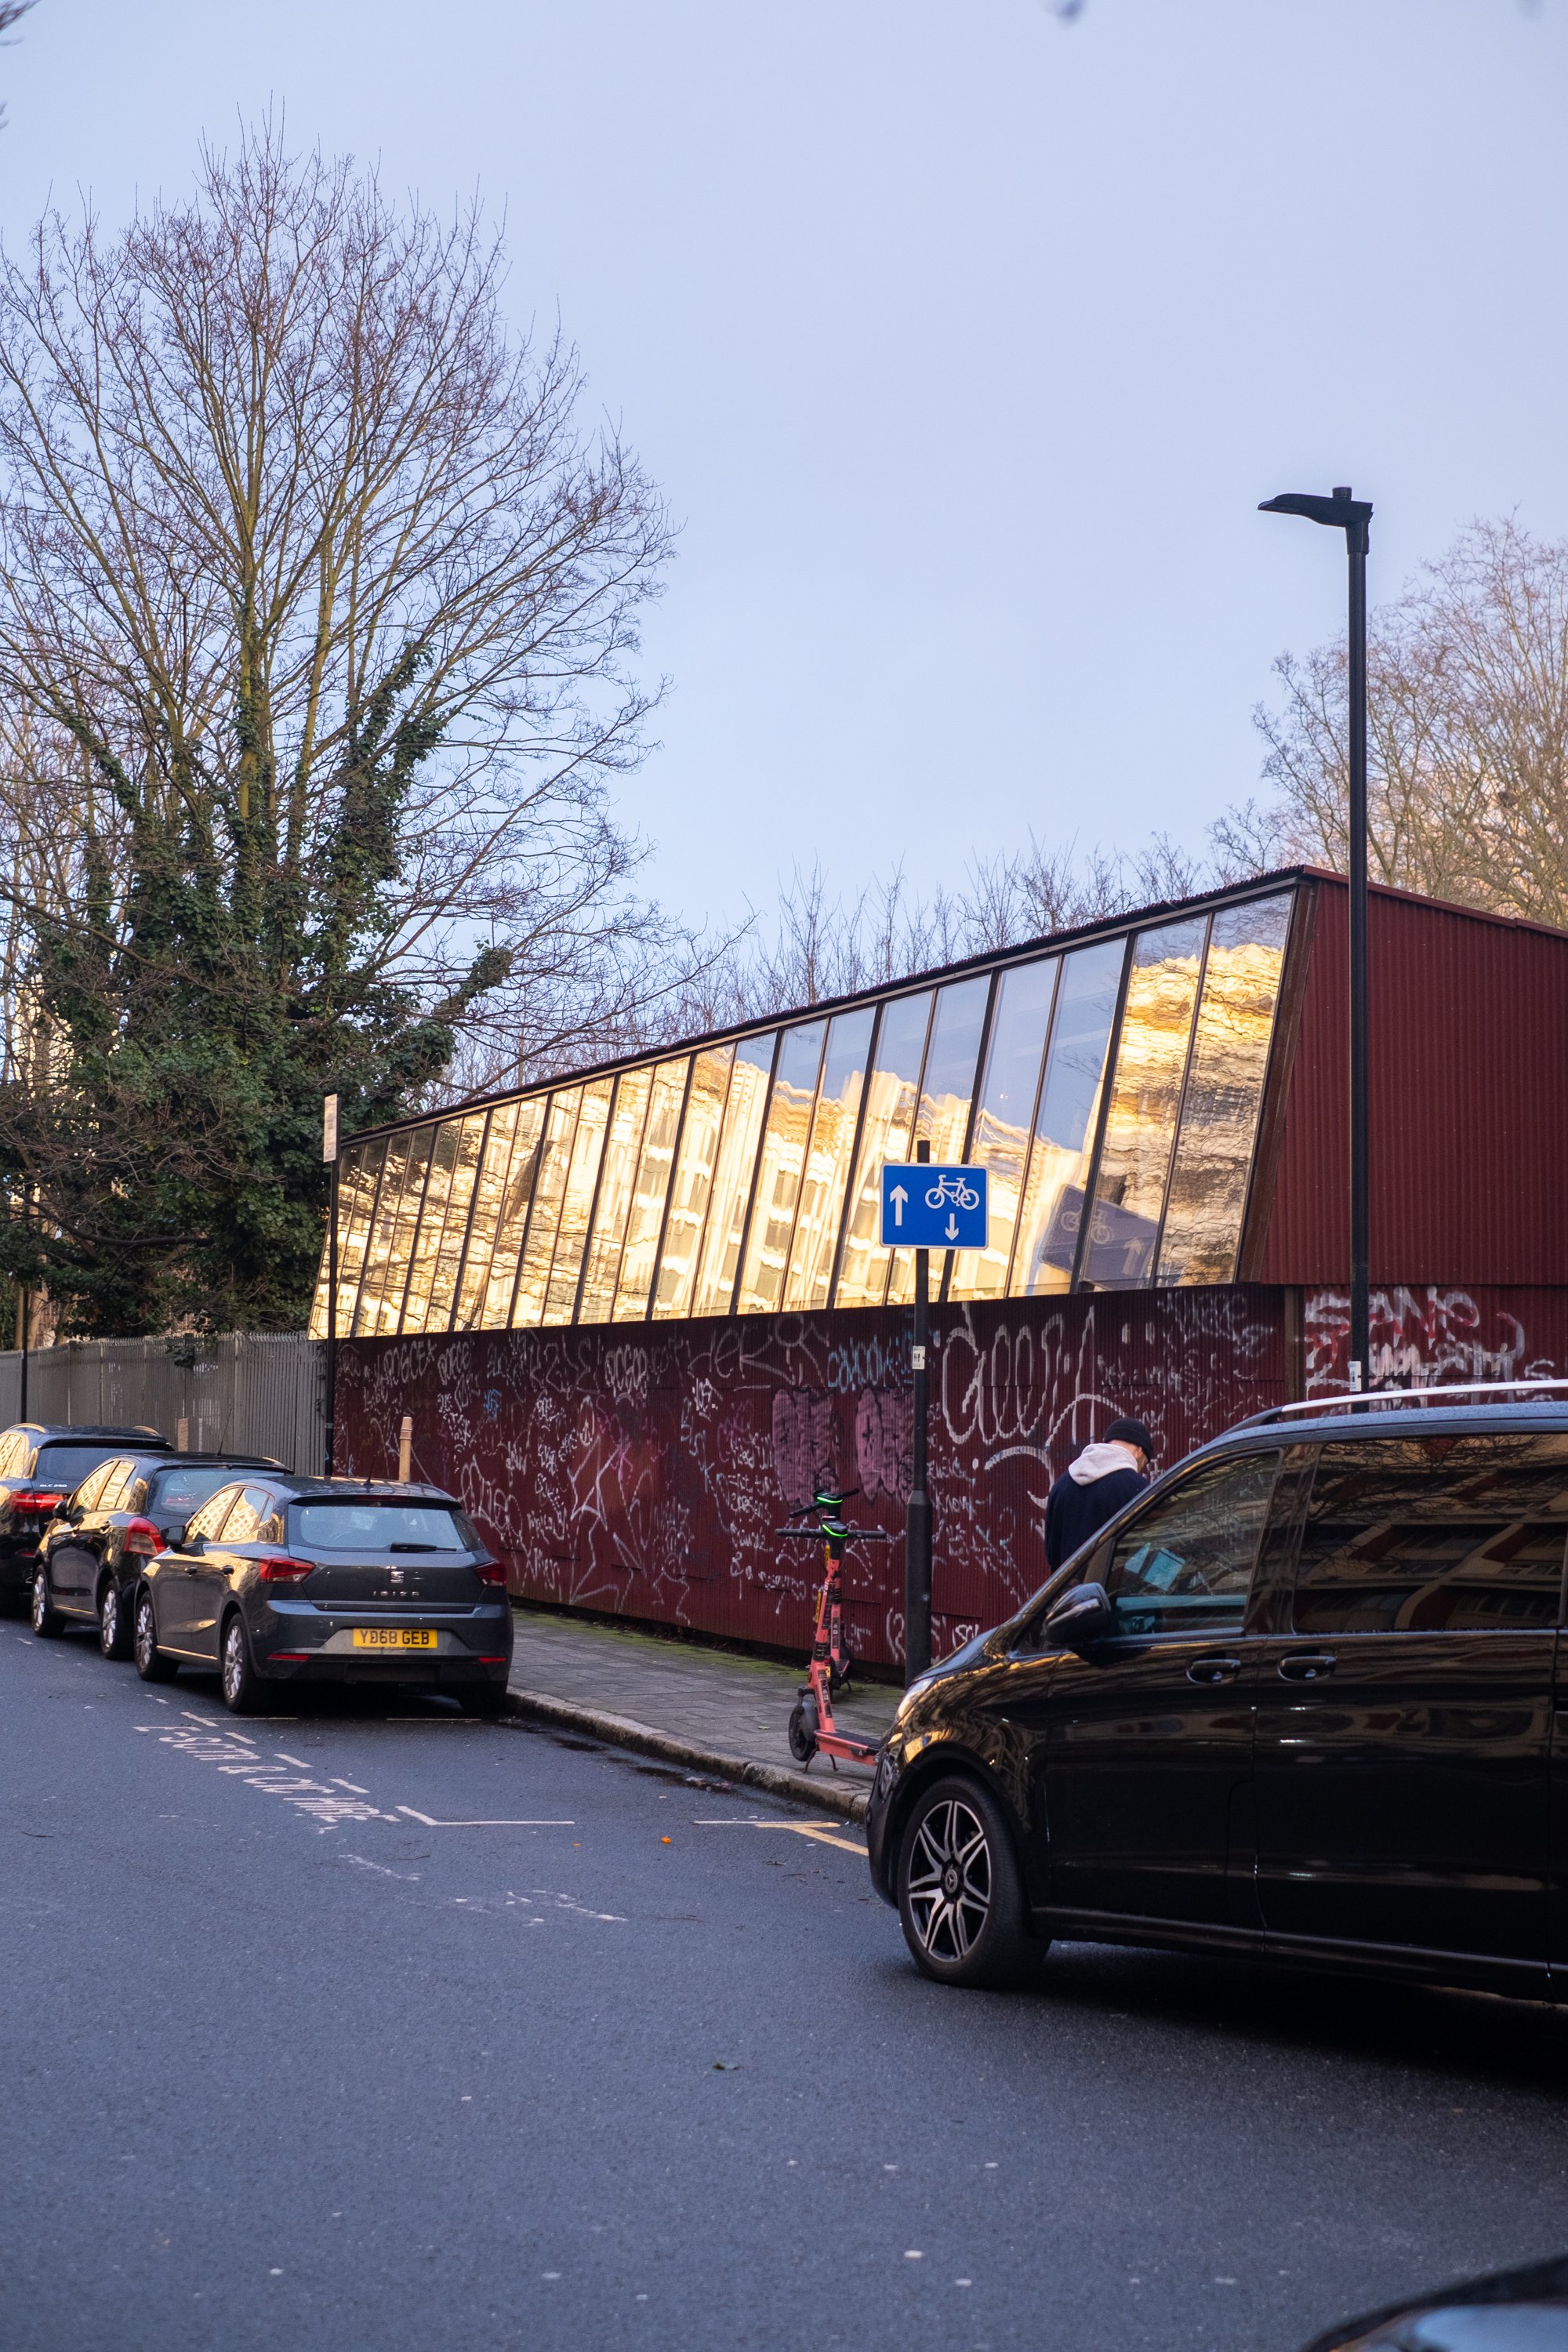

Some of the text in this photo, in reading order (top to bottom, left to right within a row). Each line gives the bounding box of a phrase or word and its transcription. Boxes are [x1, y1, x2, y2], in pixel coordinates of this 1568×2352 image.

[360, 1630, 430, 1645] YD68 GEB
[216, 1766, 288, 1774] &
[242, 1777, 336, 1794] CYC
[283, 1797, 401, 1823] HIRE
